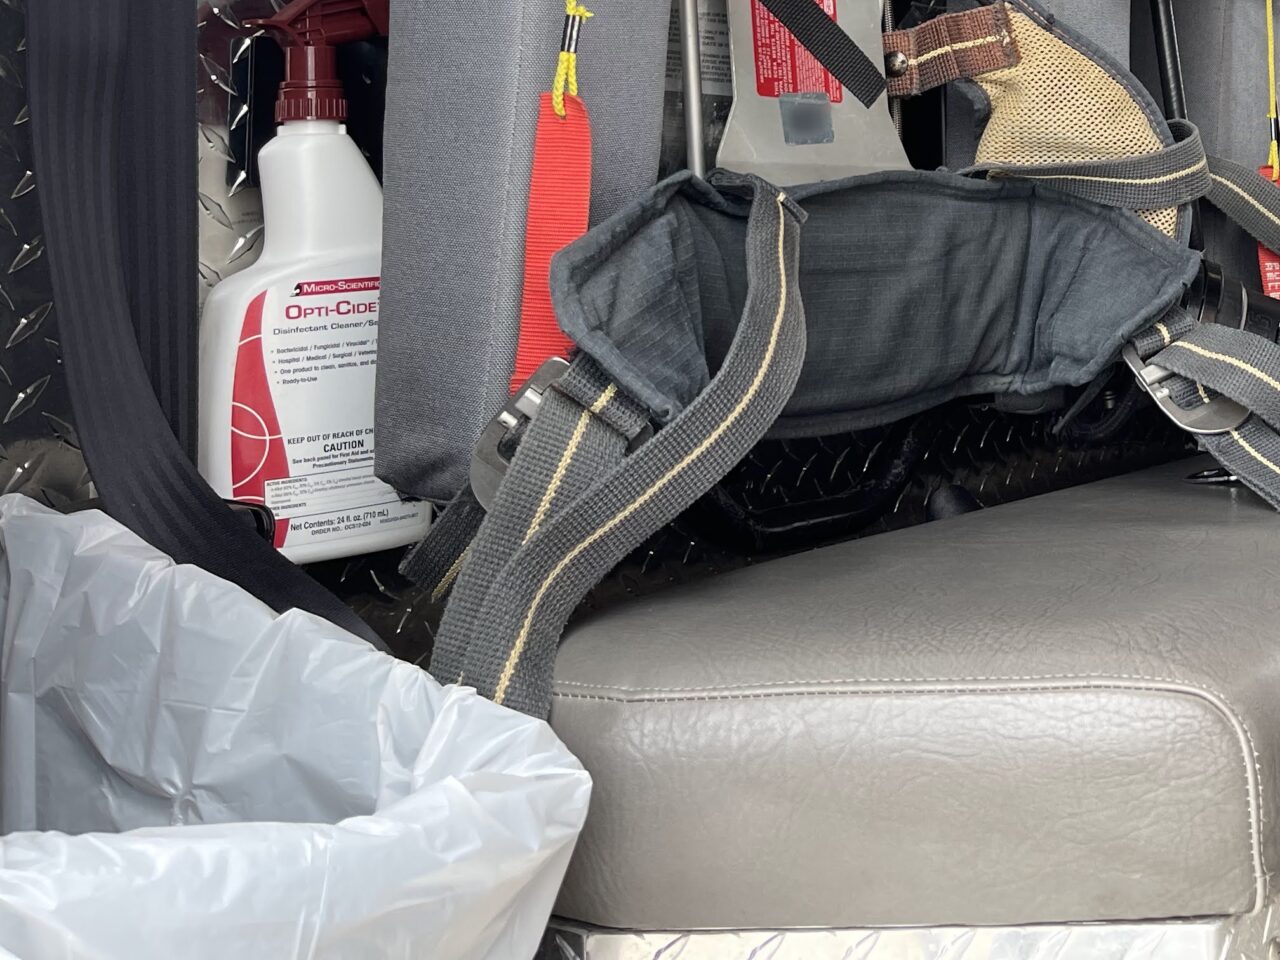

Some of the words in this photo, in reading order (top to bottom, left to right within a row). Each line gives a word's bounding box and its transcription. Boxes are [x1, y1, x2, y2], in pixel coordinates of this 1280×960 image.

[273, 325, 328, 335] Disinfectant
[278, 356, 300, 364] Hospital
[306, 354, 327, 362] Medical
[293, 366, 312, 374] product
[282, 376, 317, 385] Ready-to-Use
[288, 436, 305, 445] KEEP
[307, 435, 320, 443] OUT
[333, 430, 354, 439] REACH
[323, 440, 364, 453] CAUTION
[312, 460, 347, 469] Precautionary
[290, 523, 302, 531] Net
[303, 519, 335, 529] Contents:
[336, 516, 345, 524] 24
[363, 510, 377, 521] (710
[377, 508, 389, 518] mL)
[311, 527, 330, 536] ORDER
